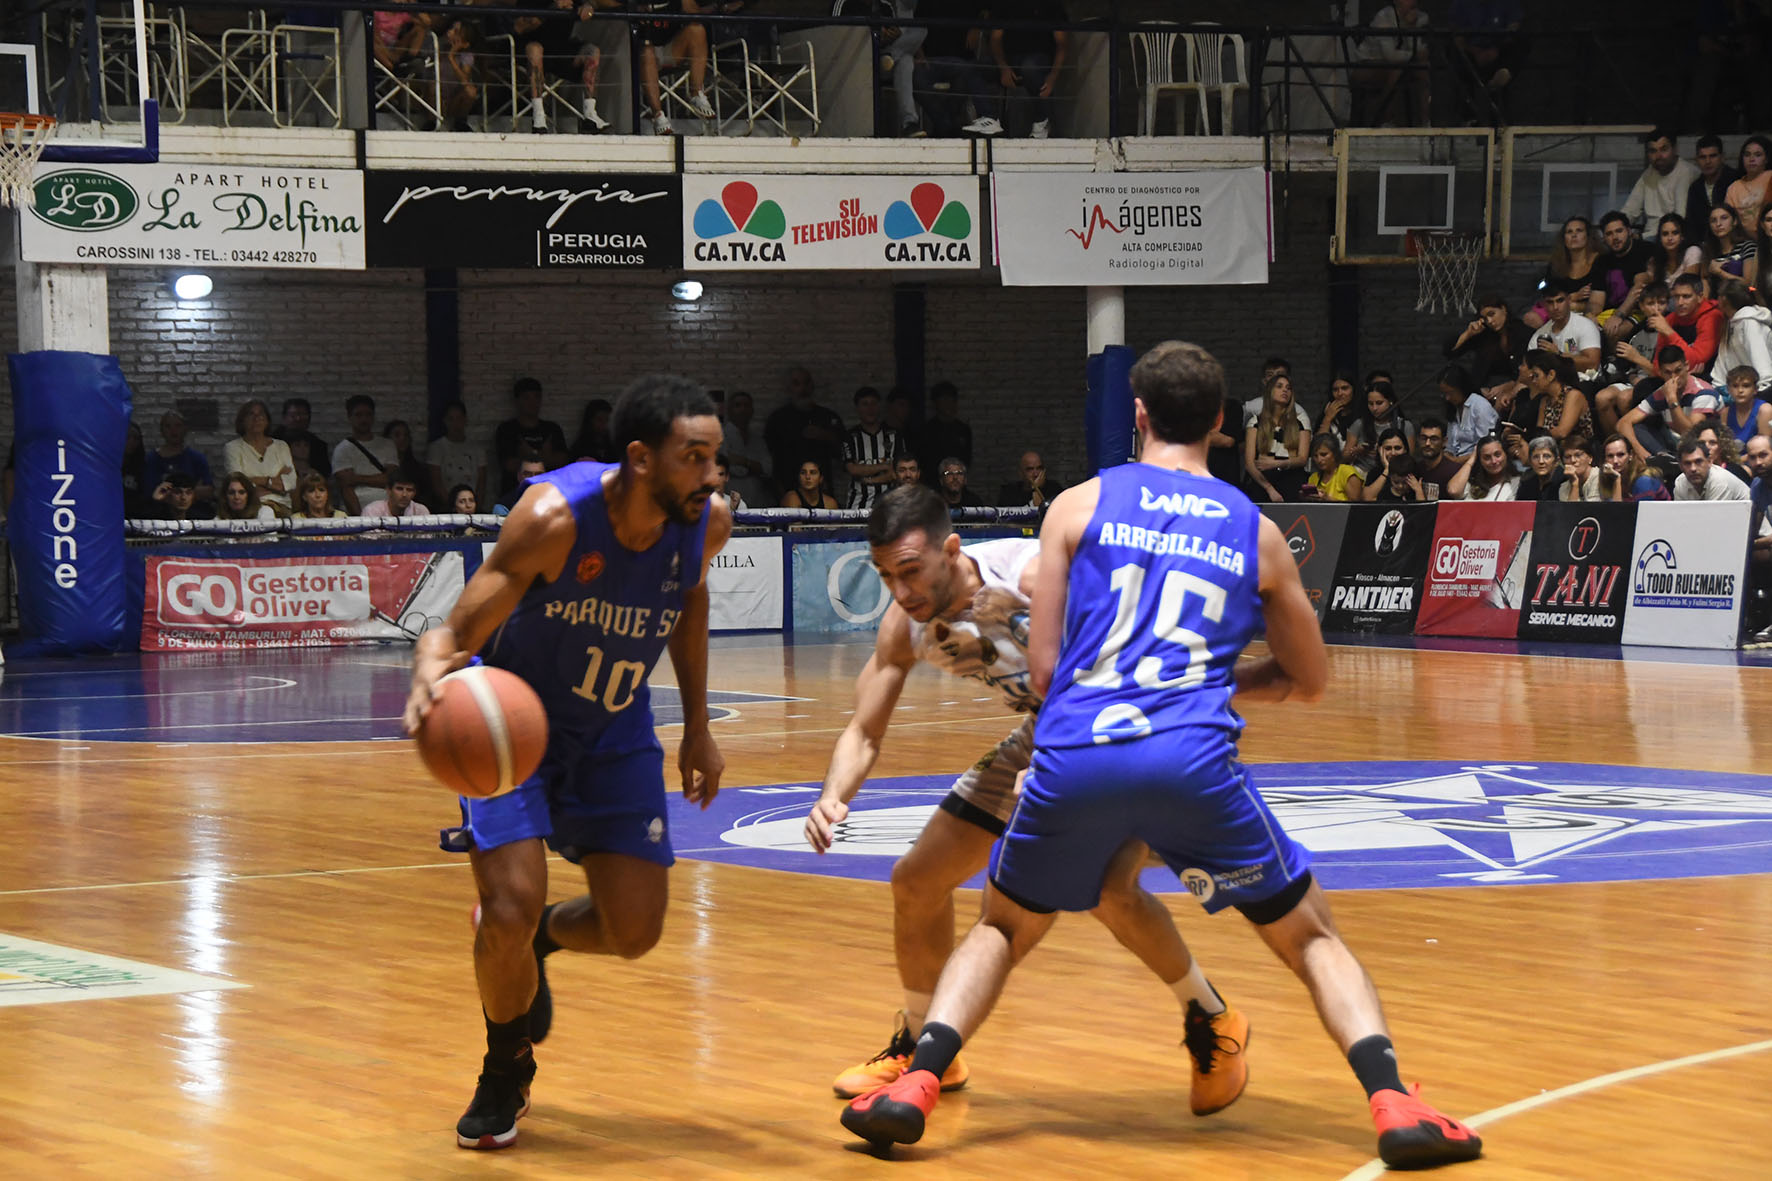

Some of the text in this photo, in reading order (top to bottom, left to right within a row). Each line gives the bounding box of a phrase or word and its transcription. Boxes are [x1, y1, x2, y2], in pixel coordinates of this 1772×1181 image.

[174, 173, 329, 189] APART HOTEL
[1085, 186, 1115, 194] CENTRO
[1118, 186, 1128, 194] DE
[1131, 185, 1182, 194] DIAGNÓSTICO
[142, 188, 361, 249] La Delfina
[839, 198, 860, 219] SU
[792, 213, 878, 245] TELEVISIÓN
[549, 233, 648, 248] PERUGIA
[1122, 242, 1203, 252] ALTA COMPLEJIDAD
[77, 246, 154, 259] CAROSSINI
[159, 249, 181, 260] 138
[193, 249, 227, 261] TEL.:
[232, 250, 268, 262] 03442
[273, 251, 317, 263] 428270
[549, 253, 645, 265] DESARROLLOS
[694, 242, 786, 262] CA.TV.CA
[884, 242, 971, 262] CA.TV.CA
[1169, 258, 1204, 270] Digital
[1436, 545, 1459, 574] GO
[1462, 544, 1496, 559] Gestoría
[1460, 560, 1483, 575] Oliver
[248, 571, 362, 594] Gestoría
[1531, 564, 1621, 607] TANI
[1647, 573, 1735, 596] TODO RULEMANES
[166, 574, 237, 616] GO
[1331, 586, 1414, 611] PANTHER
[250, 596, 331, 618] Oliver
[544, 597, 682, 638] PARQUE S
[1072, 563, 1228, 690] 15
[1528, 612, 1616, 627] SERVICE MECANICO
[158, 629, 220, 639] FLORENCIA
[224, 630, 292, 639] TAMBURLINI
[301, 629, 326, 638] MAT.
[158, 638, 165, 647] 9
[168, 638, 184, 648] DE
[185, 638, 217, 648] JULIO
[572, 646, 645, 712] 10
